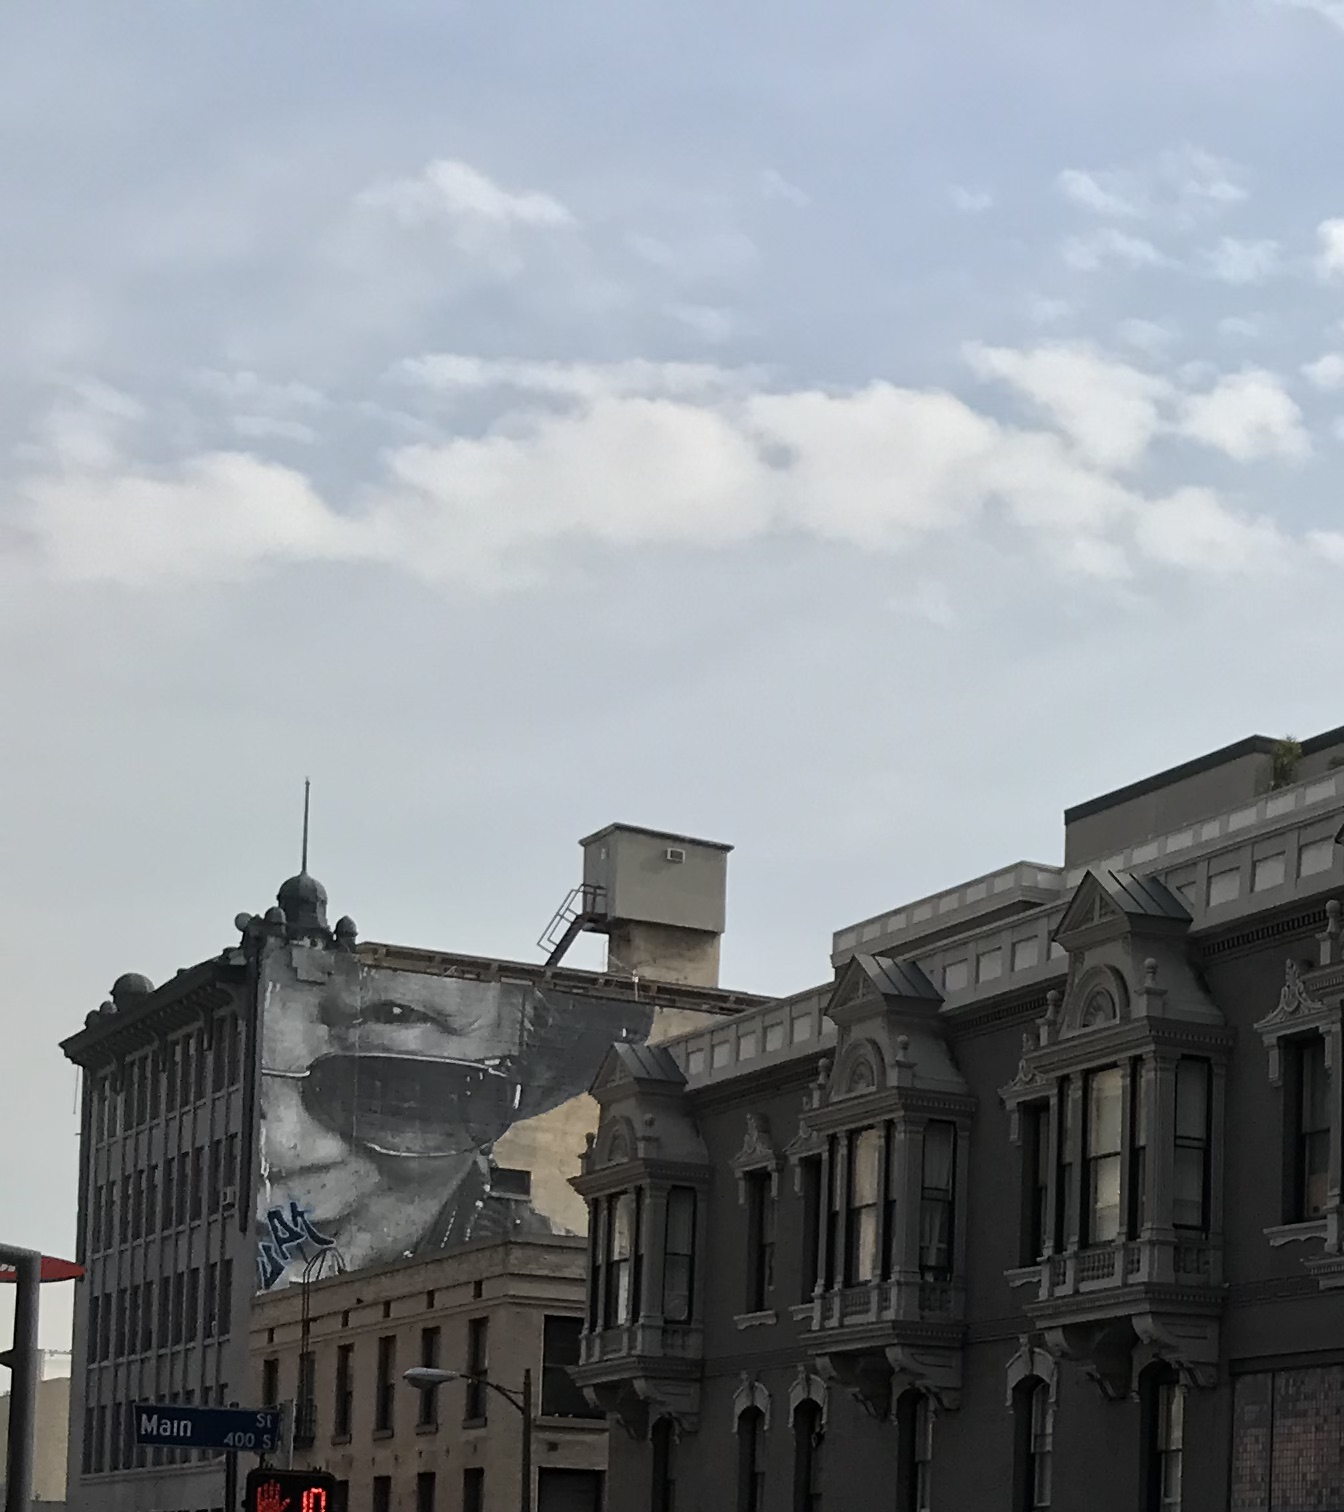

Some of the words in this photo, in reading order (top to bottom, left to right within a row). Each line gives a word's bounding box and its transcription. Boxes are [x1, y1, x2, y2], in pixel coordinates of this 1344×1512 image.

[140, 1414, 192, 1437] Main
[256, 1414, 272, 1428] St
[224, 1432, 255, 1447] 400
[262, 1434, 272, 1448] S
